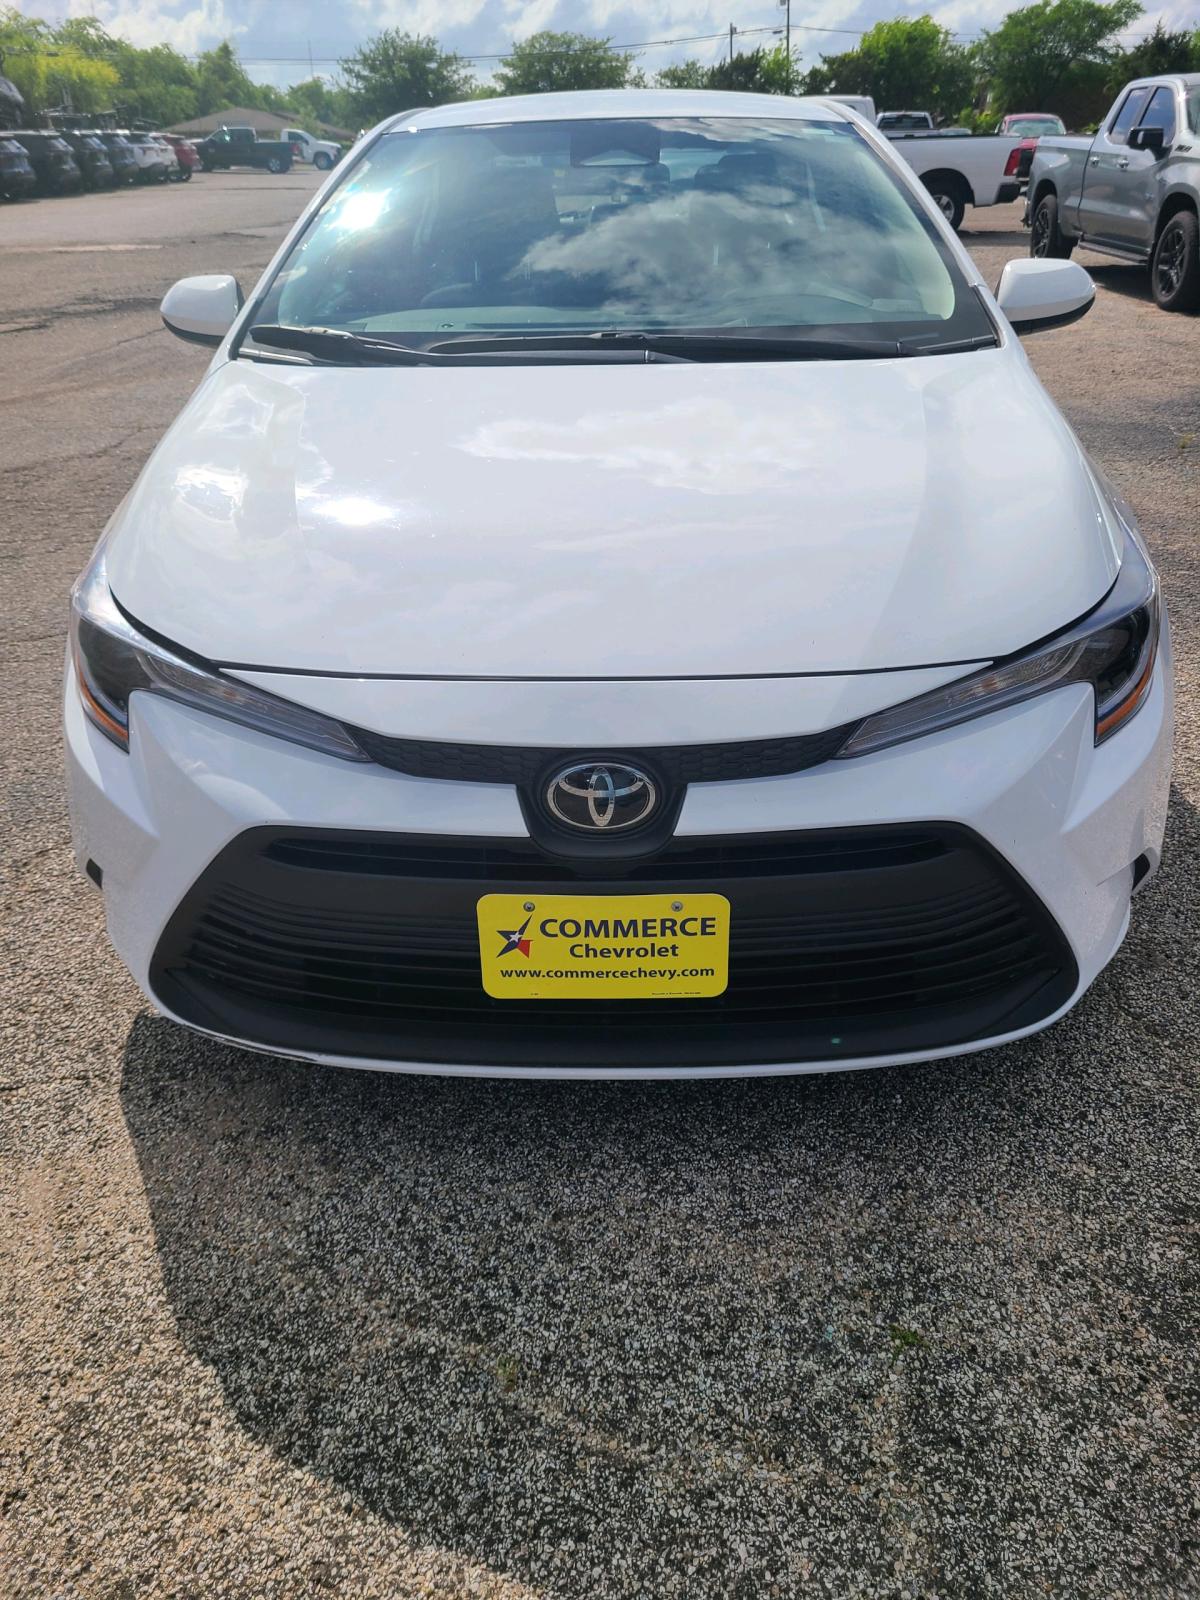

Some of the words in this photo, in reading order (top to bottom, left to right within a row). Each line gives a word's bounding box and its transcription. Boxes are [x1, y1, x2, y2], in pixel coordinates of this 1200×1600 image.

[539, 917, 716, 938] COMMERCE
[569, 942, 679, 959] Chevrolet
[500, 966, 715, 981] www.commercechevy.com
